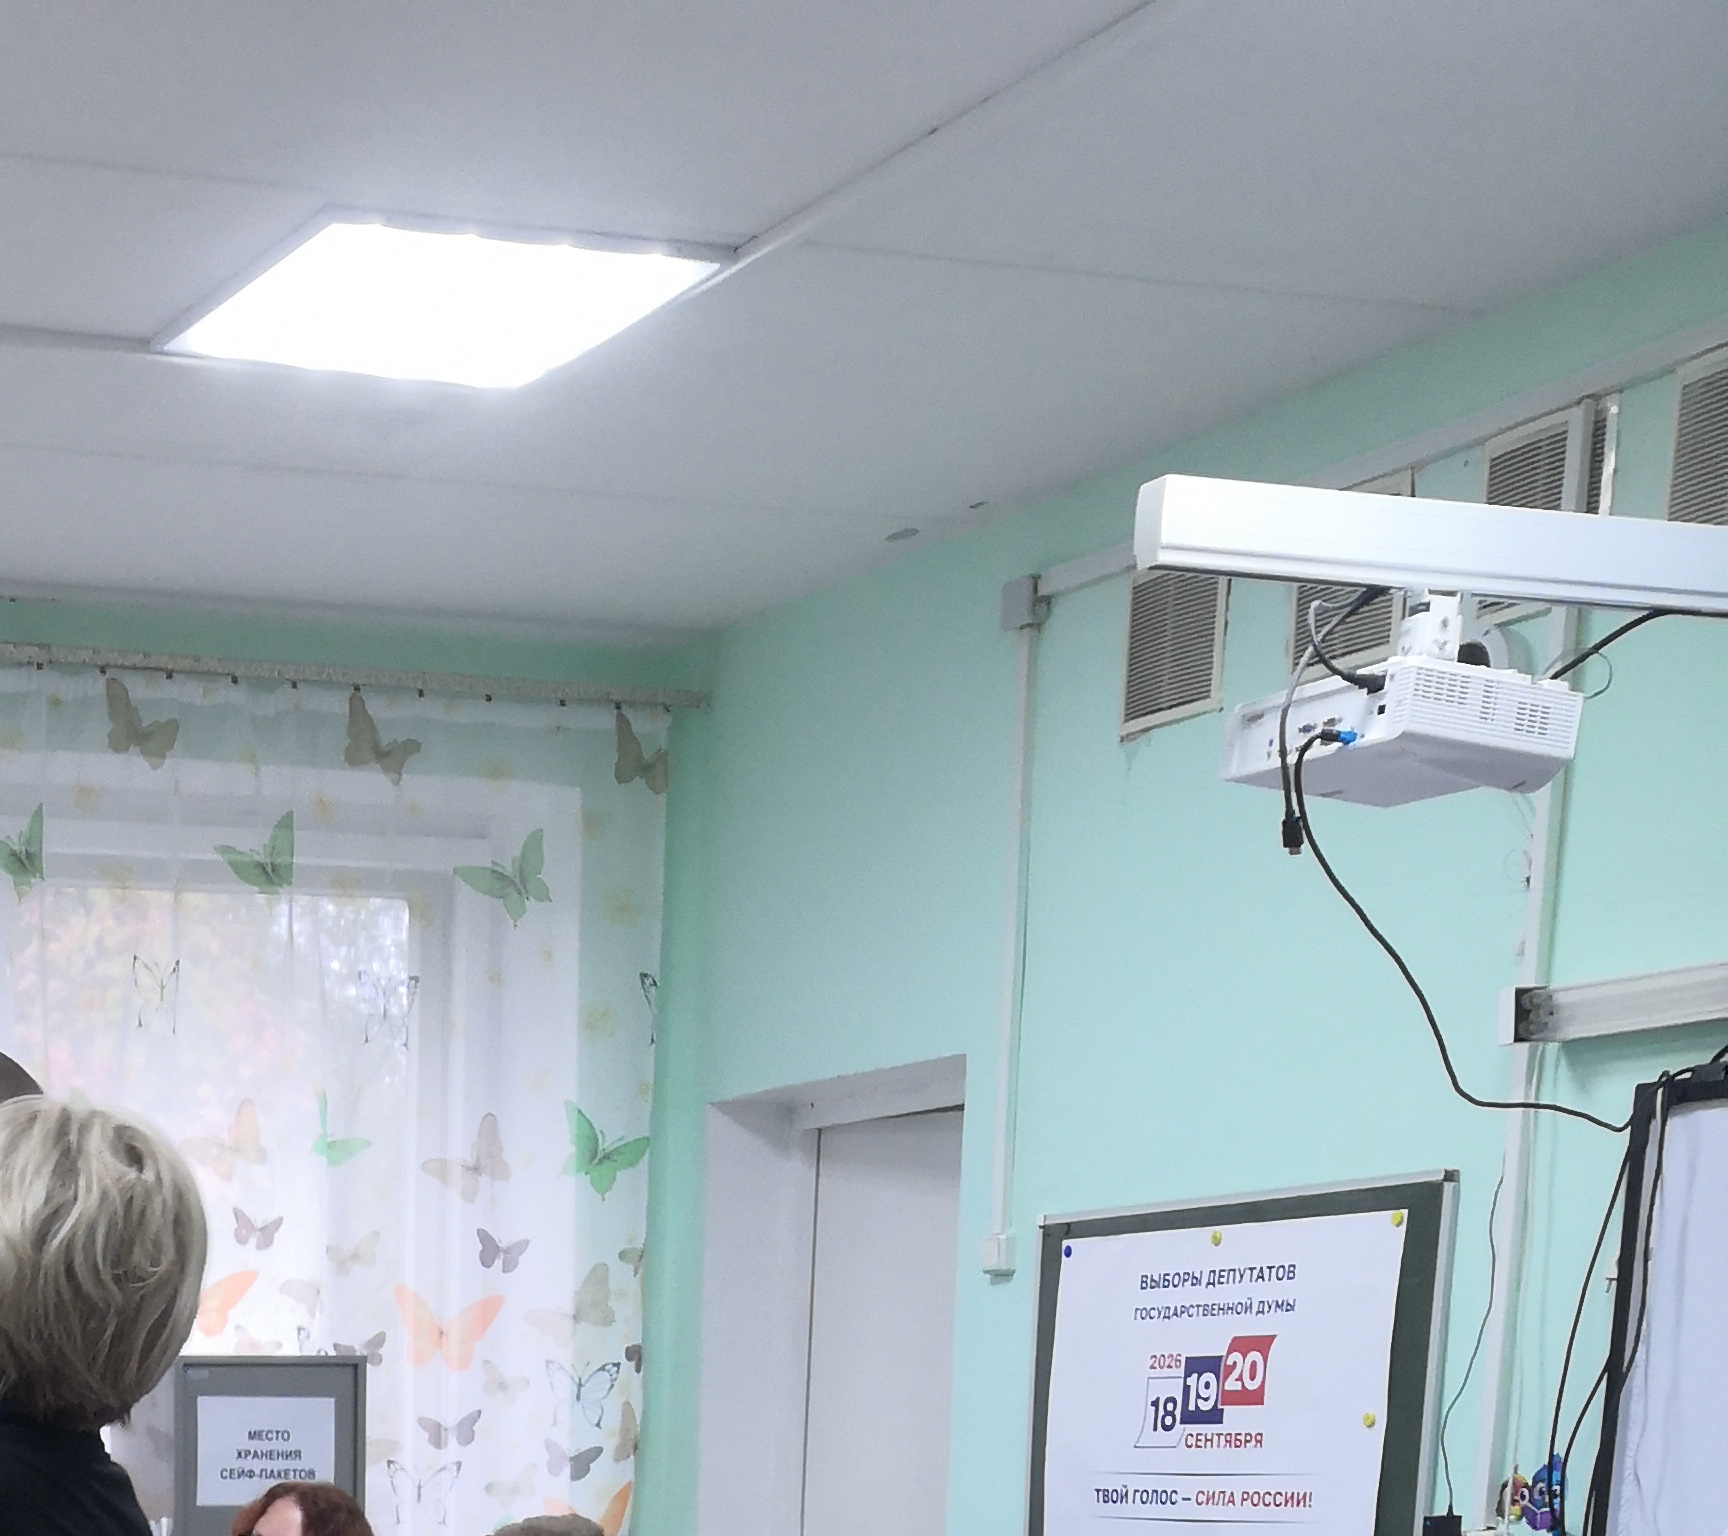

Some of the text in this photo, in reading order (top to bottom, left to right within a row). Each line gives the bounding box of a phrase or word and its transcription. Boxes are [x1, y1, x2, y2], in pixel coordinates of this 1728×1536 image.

[1140, 1264, 1297, 1290] ВЫБОРЫ ДЕПУТАТОВ
[1133, 1297, 1297, 1321] ГОСУДАРСТВЕННОЙ ДУМЫ
[1149, 1353, 1182, 1370] 2026
[1150, 1350, 1264, 1432] 18 19 20
[247, 1429, 291, 1442] МЕСТО
[1184, 1432, 1264, 1449] СЕНТЯБРЯ
[235, 1448, 303, 1461] ХРАНЕНИЯ
[220, 1466, 317, 1480] СЕЙФ-ПАКЕТОВ
[1094, 1484, 1129, 1506] ТВОЙ
[1132, 1489, 1179, 1505] ГОЛОС
[1195, 1490, 1236, 1507] СИЛА
[1240, 1491, 1313, 1508] РОССИИ!
